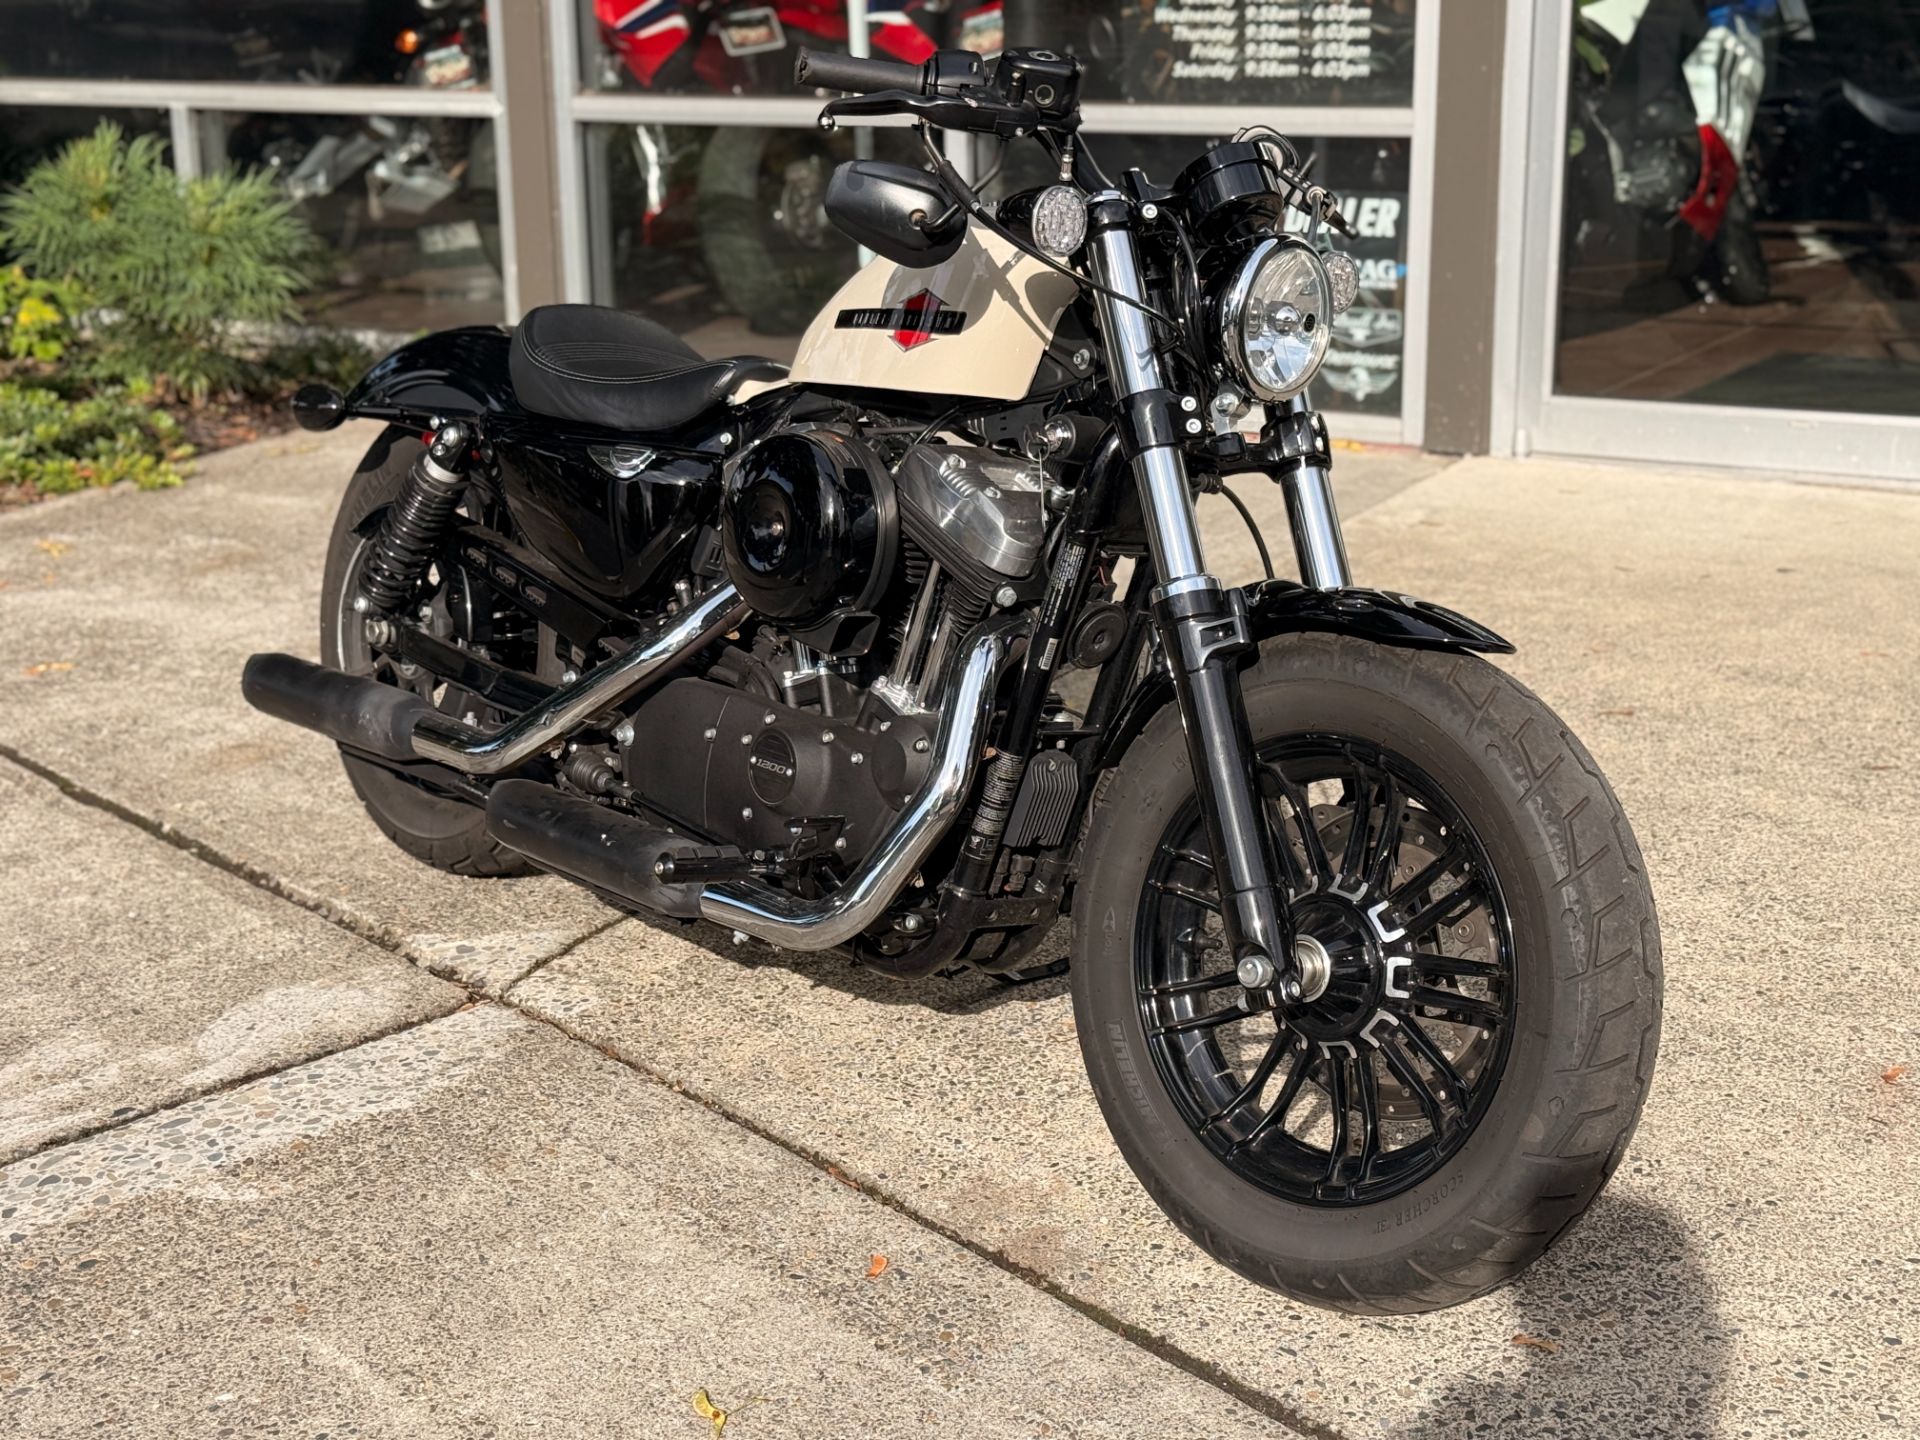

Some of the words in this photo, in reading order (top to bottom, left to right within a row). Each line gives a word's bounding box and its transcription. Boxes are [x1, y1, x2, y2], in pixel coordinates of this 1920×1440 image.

[1154, 7, 1238, 27] Wednesday
[1172, 25, 1238, 45] Thursday
[1189, 42, 1238, 63] Friday
[1171, 61, 1238, 82] Saturday
[756, 758, 786, 774] 1200
[1395, 1168, 1464, 1227] SCORCHER
